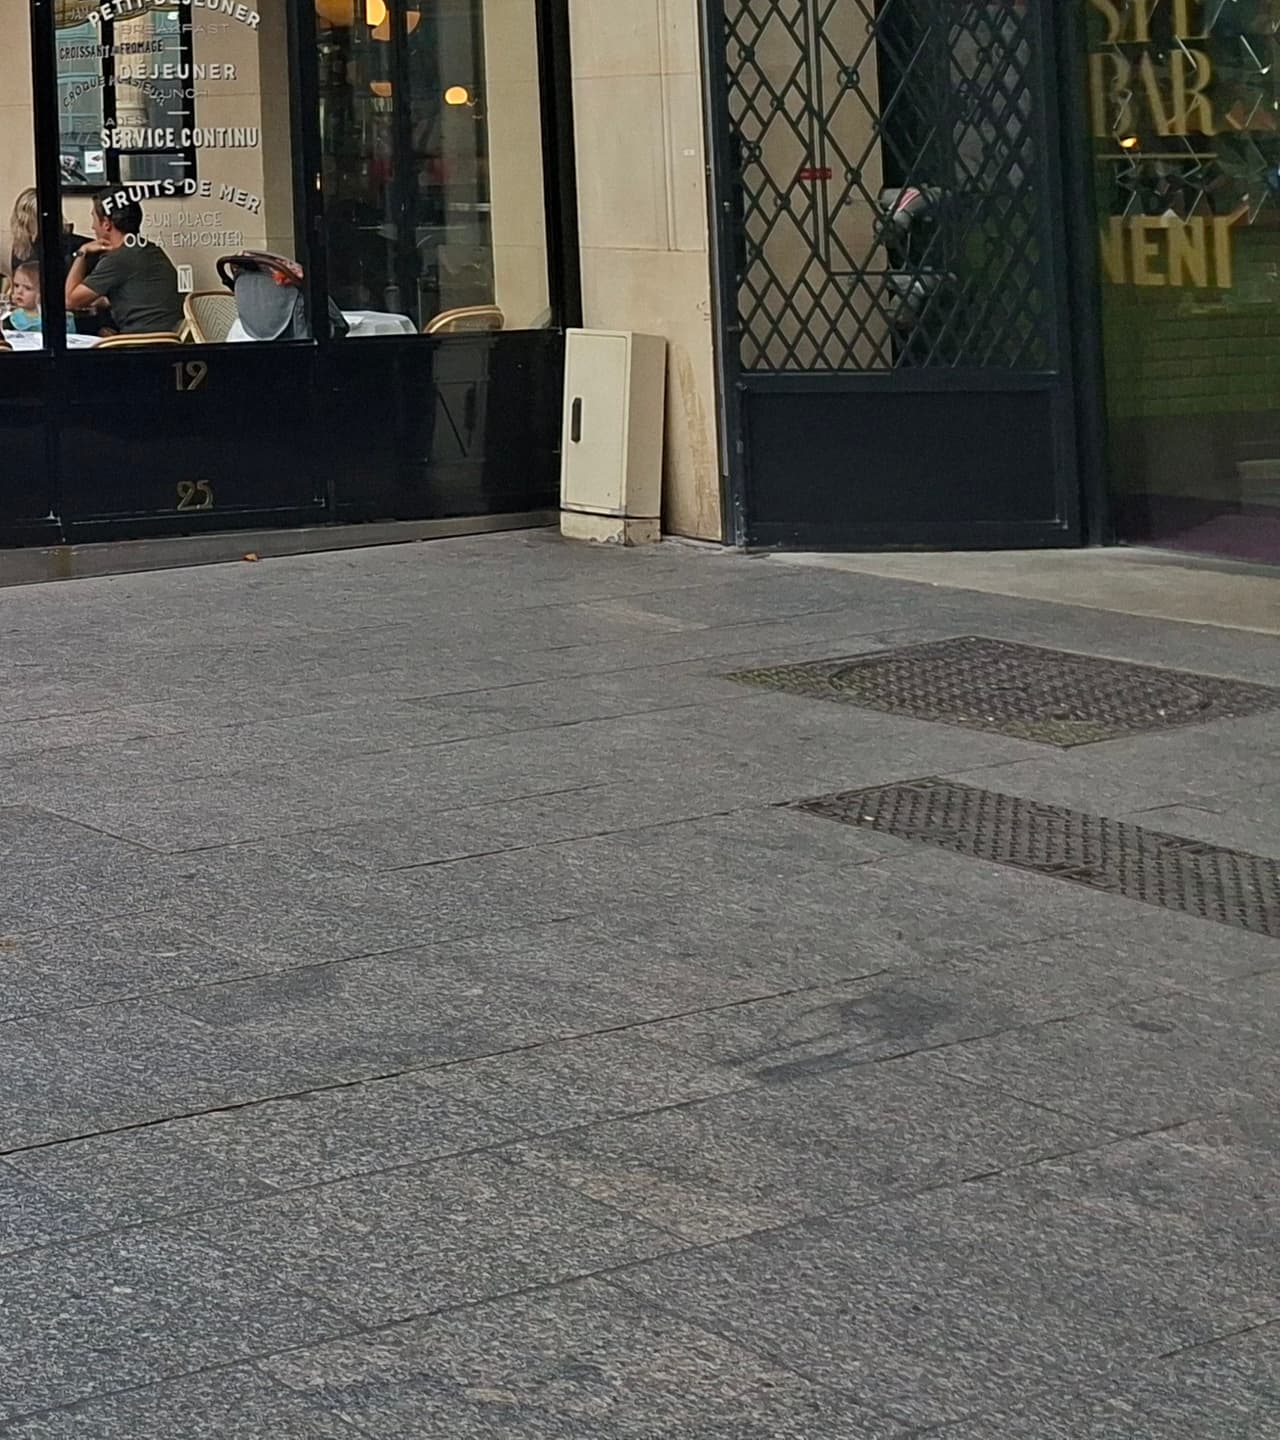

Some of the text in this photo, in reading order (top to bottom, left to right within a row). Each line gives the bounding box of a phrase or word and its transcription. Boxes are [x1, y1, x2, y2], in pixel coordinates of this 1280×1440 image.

[121, 23, 230, 35] BREAKFAST
[59, 44, 110, 60] CROISSANT
[120, 39, 164, 55] FROMAGE
[120, 59, 237, 81] DÉJEUNER
[1088, 49, 1217, 137] BAR
[101, 127, 175, 149] SERVICE
[181, 127, 259, 149] CONTINU
[102, 178, 262, 215] FRUITS DE MER
[145, 212, 222, 228] SUR PLACE
[124, 233, 147, 248] OU
[172, 231, 244, 248] EMPORTER
[171, 360, 208, 391] 19
[176, 479, 214, 511] 25
